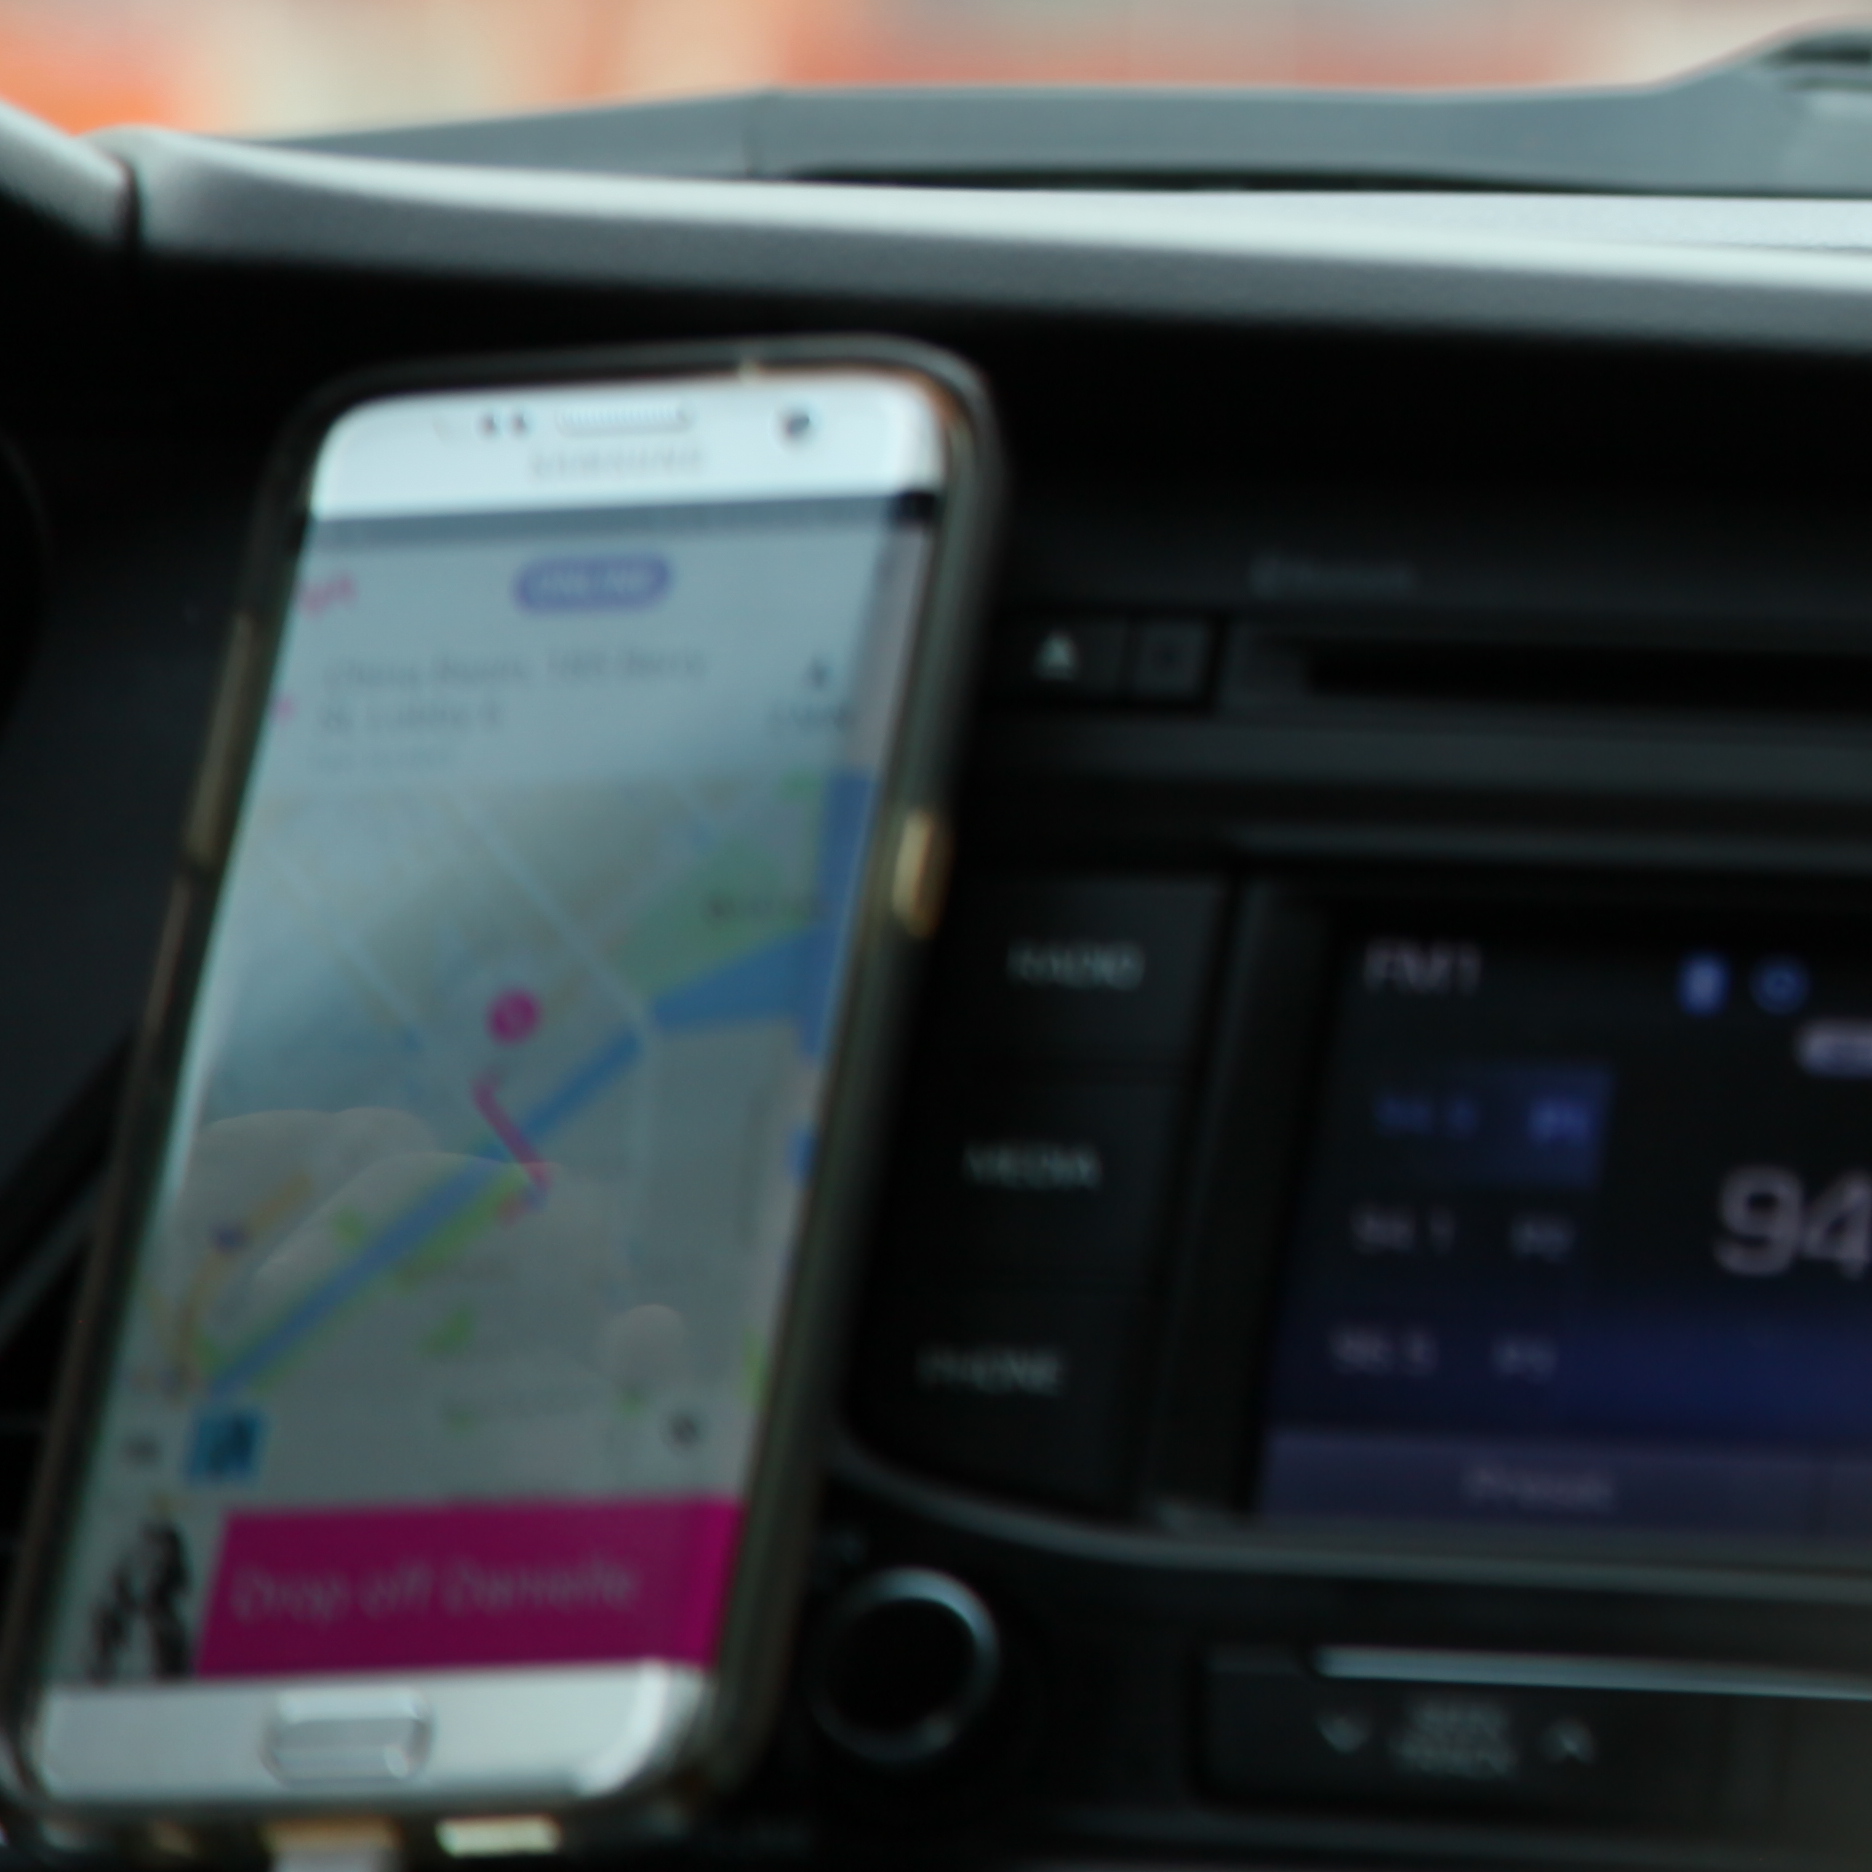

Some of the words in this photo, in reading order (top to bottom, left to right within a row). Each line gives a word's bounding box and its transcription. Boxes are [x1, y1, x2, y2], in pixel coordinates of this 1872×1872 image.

[527, 448, 704, 480] SAMSUNG
[1006, 938, 1146, 990] RADIO
[1364, 938, 1482, 996] FM1
[962, 1139, 1103, 1191] MEDIA
[915, 1342, 1064, 1396] PHONE
[230, 1558, 351, 1632] Drop
[361, 1555, 431, 1623] off
